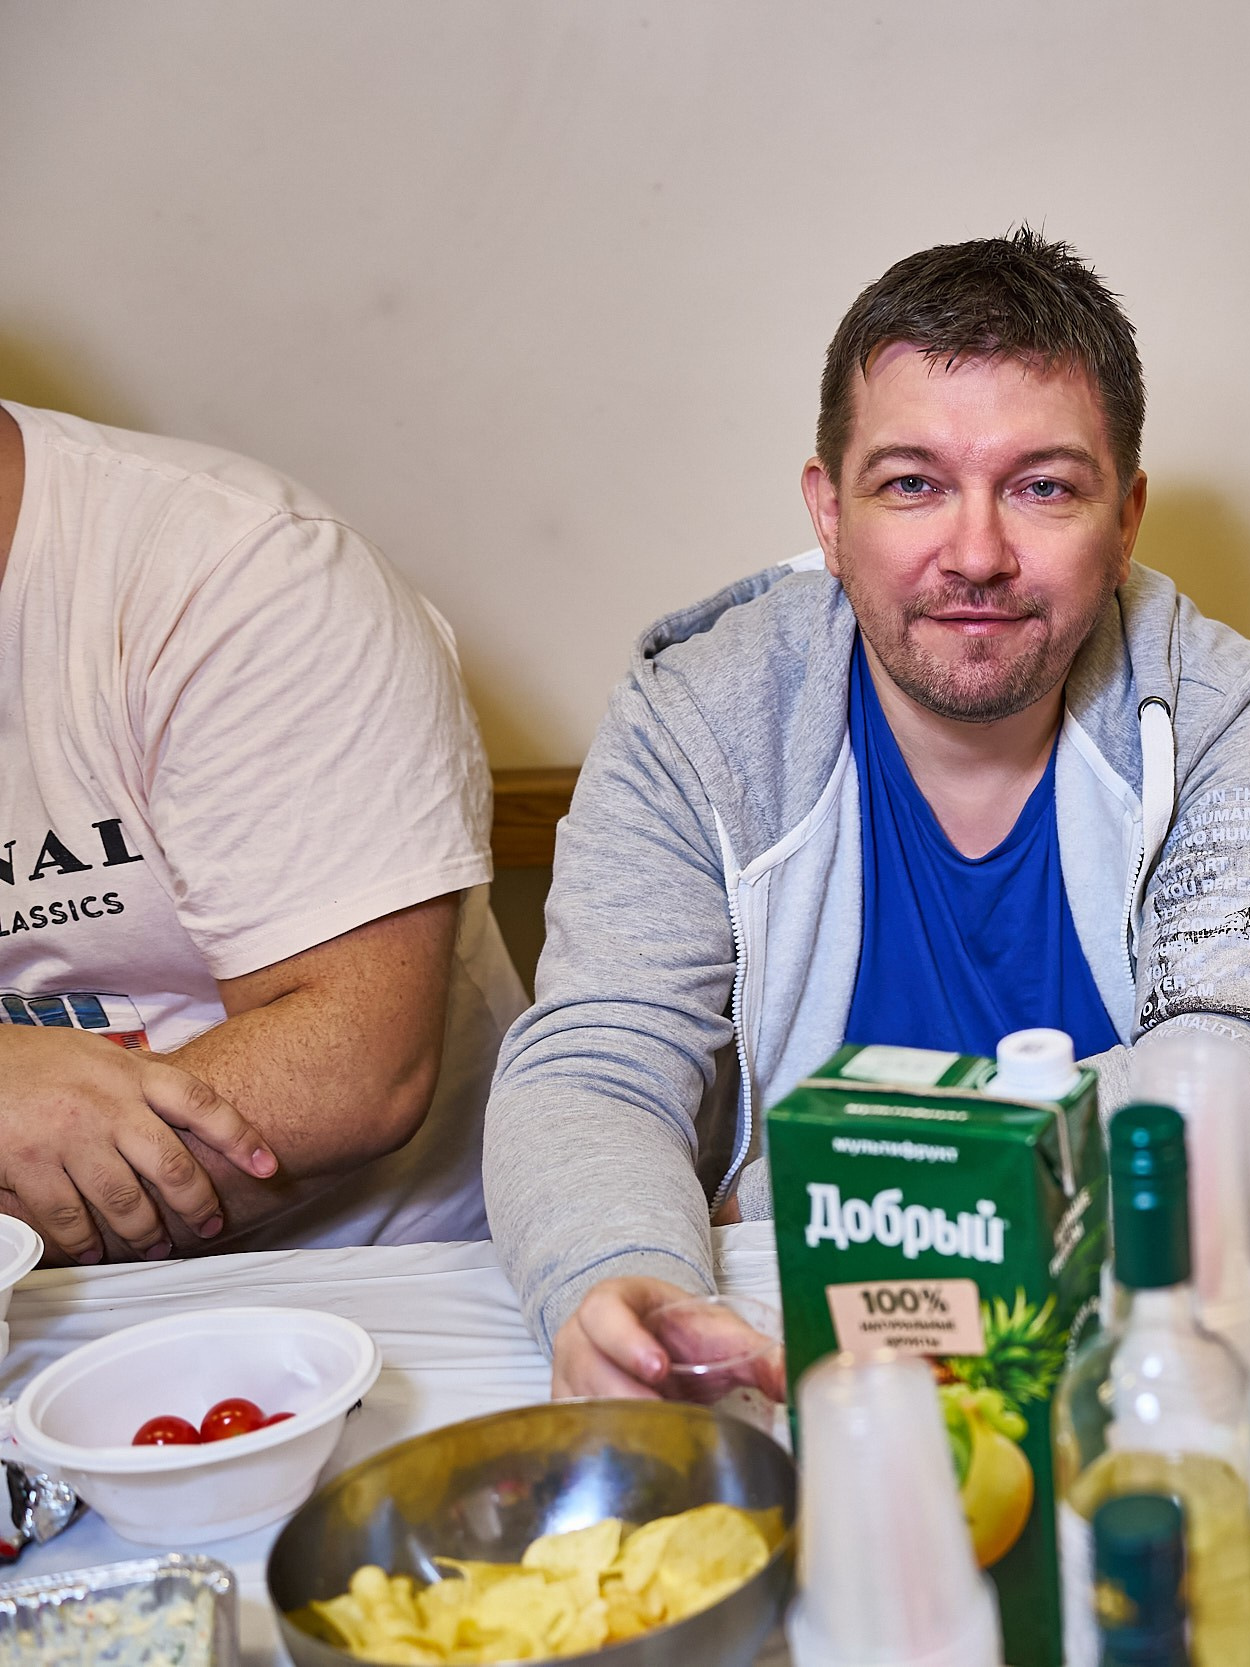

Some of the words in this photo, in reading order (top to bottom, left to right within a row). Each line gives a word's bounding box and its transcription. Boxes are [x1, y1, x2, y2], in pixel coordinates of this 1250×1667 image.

[1198, 787, 1226, 806] ON
[1181, 829, 1207, 850] NO
[1163, 879, 1197, 900] YOU
[805, 1182, 1005, 1264] Добрый
[861, 1287, 948, 1315] 100%
